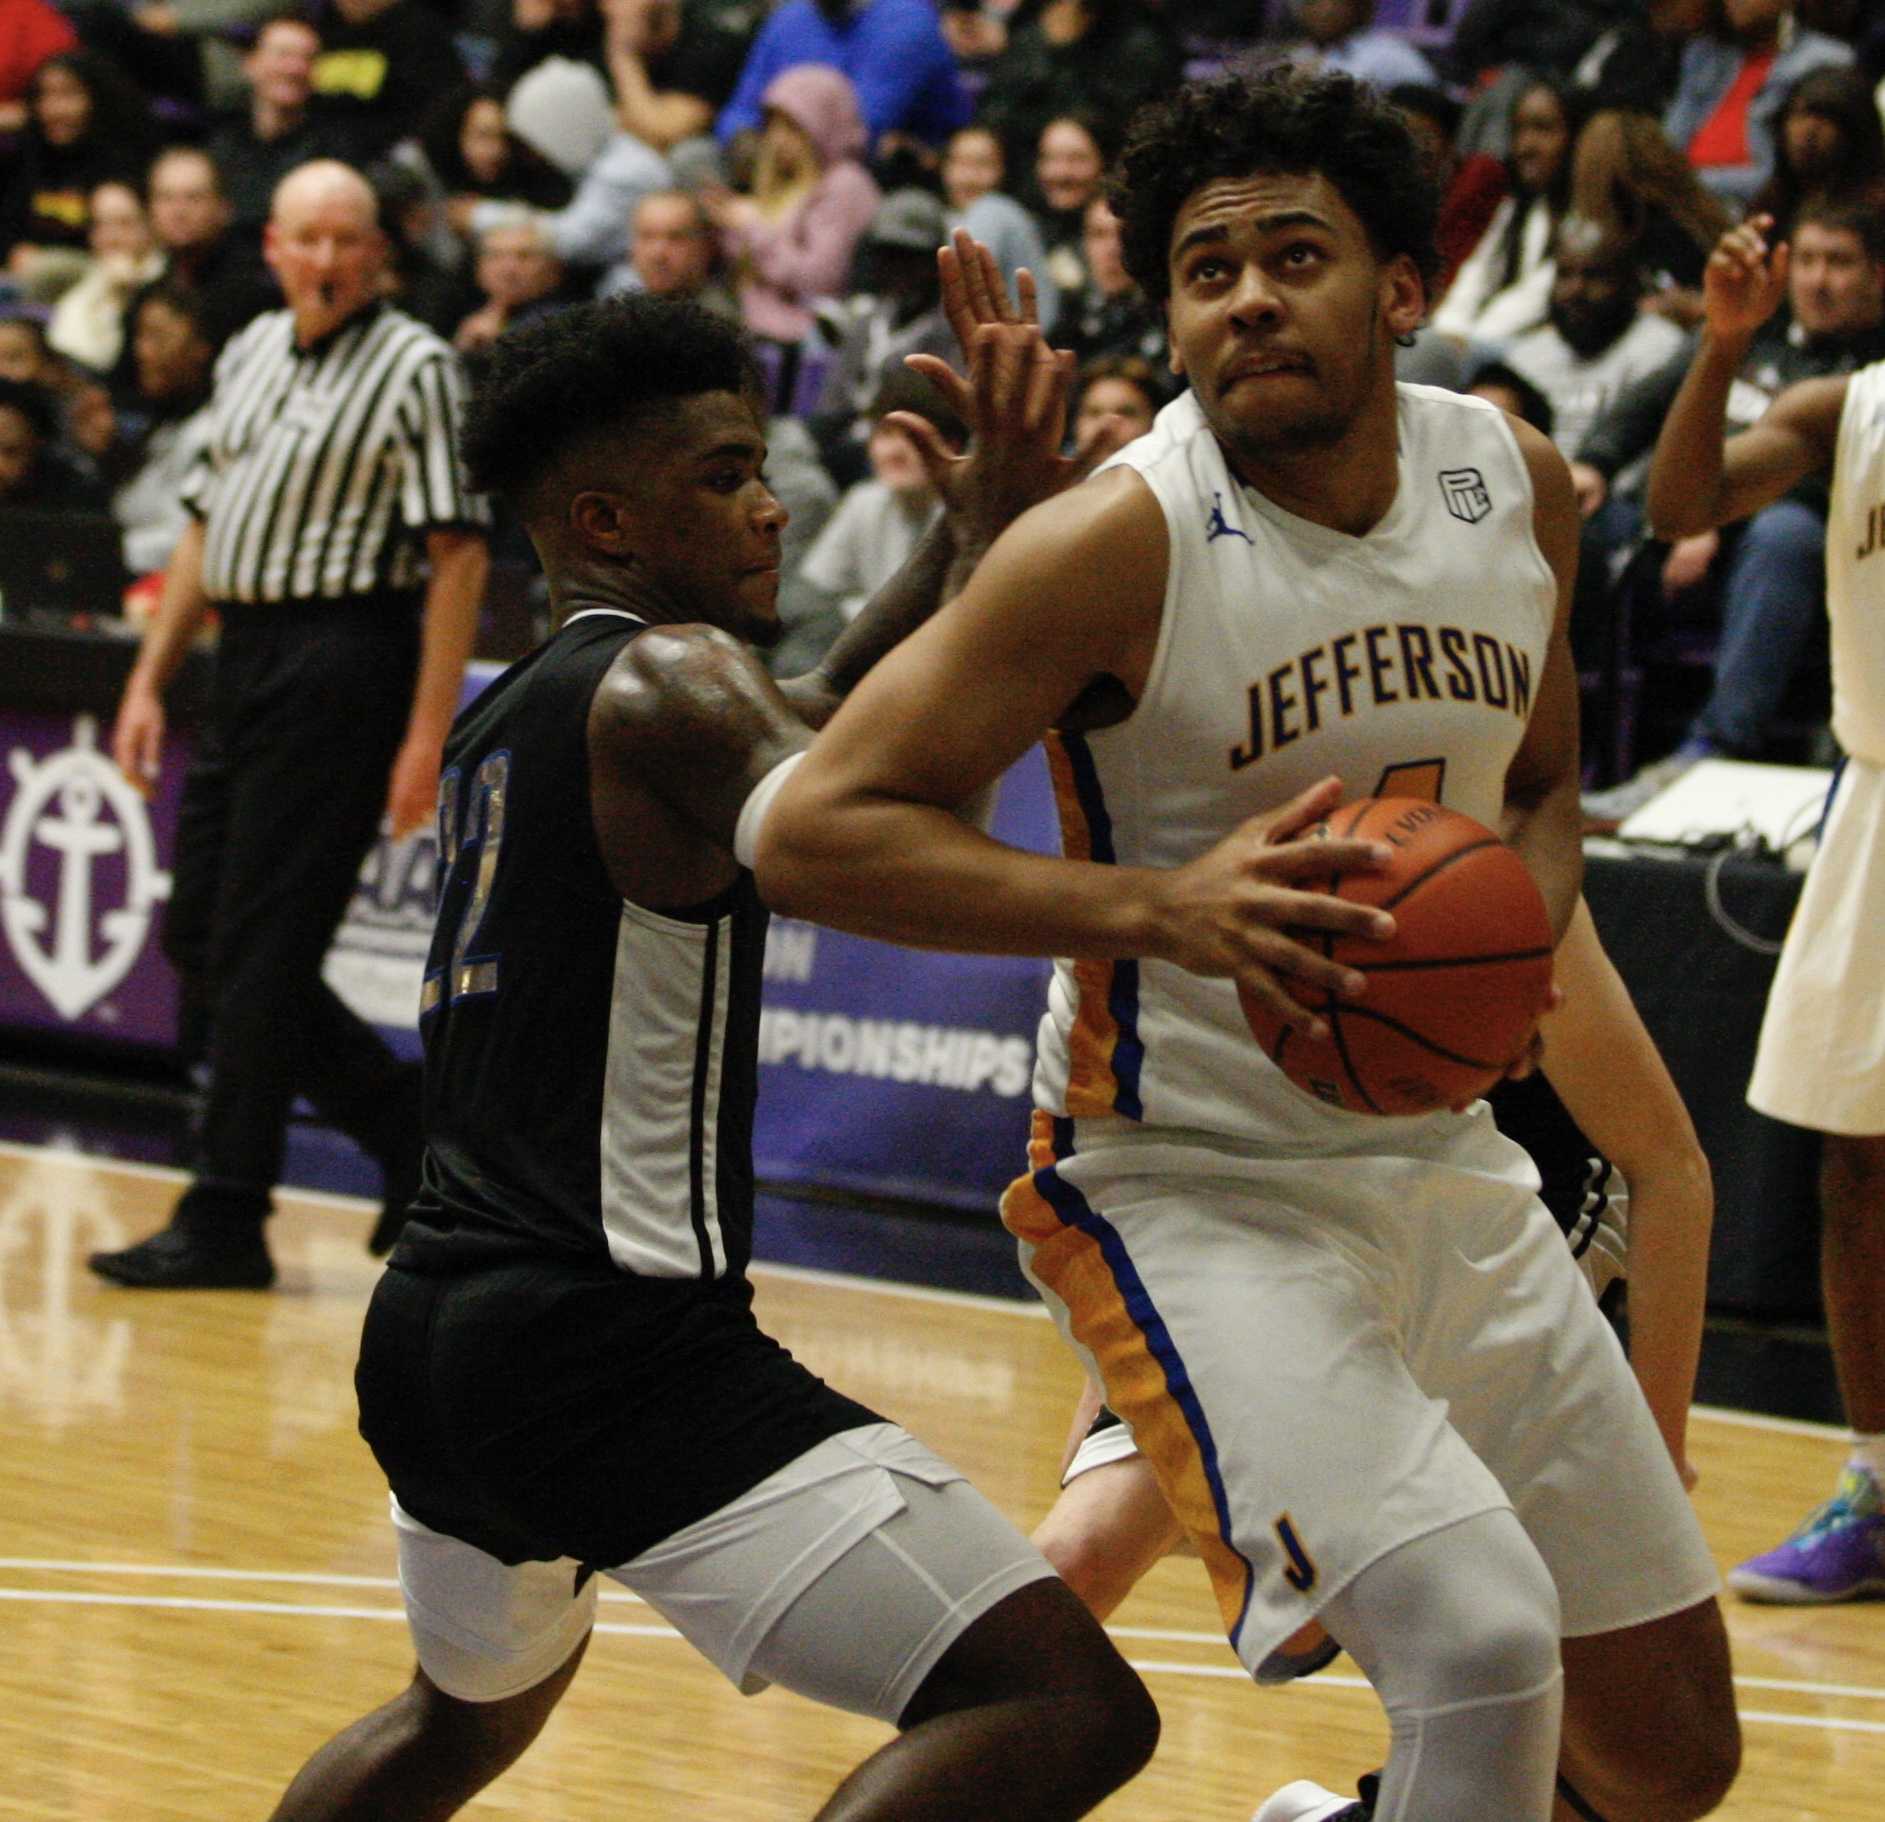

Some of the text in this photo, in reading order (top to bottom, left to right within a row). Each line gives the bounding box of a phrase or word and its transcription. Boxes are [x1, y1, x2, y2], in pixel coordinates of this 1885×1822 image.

[1855, 504, 1885, 560] J
[1228, 622, 1530, 771] JEFFERSON
[1271, 1510, 1319, 1597] J
